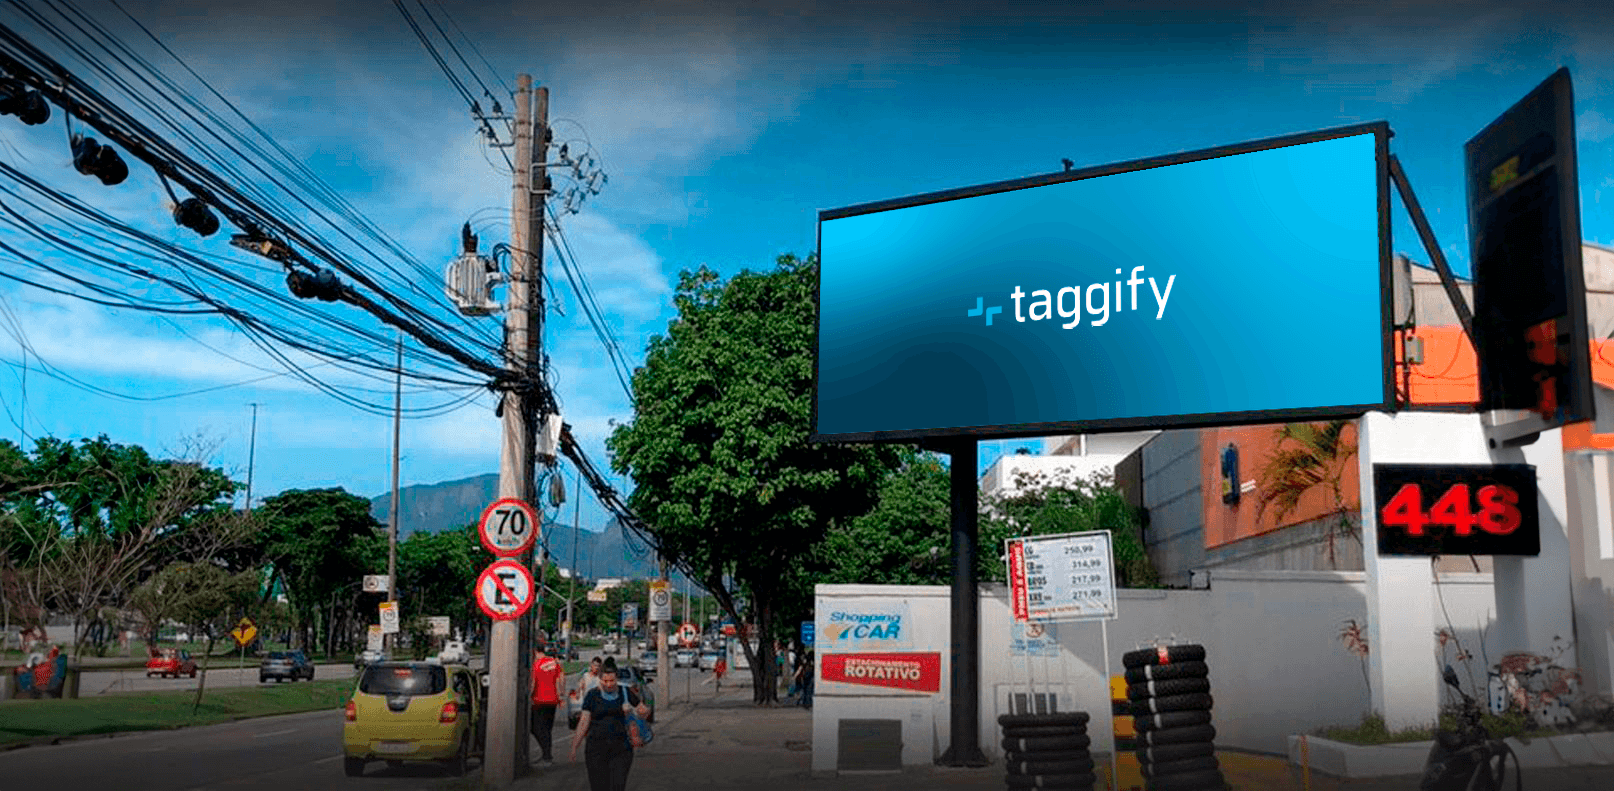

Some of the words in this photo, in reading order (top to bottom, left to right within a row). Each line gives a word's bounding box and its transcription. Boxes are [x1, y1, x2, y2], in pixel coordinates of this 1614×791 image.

[1011, 265, 1176, 329] taggify
[496, 509, 525, 535] 70
[1381, 483, 1522, 535] 448
[495, 573, 515, 605] E
[830, 611, 901, 624] Shopping
[854, 624, 901, 639] CAR
[845, 665, 921, 680] ROTATIVO
